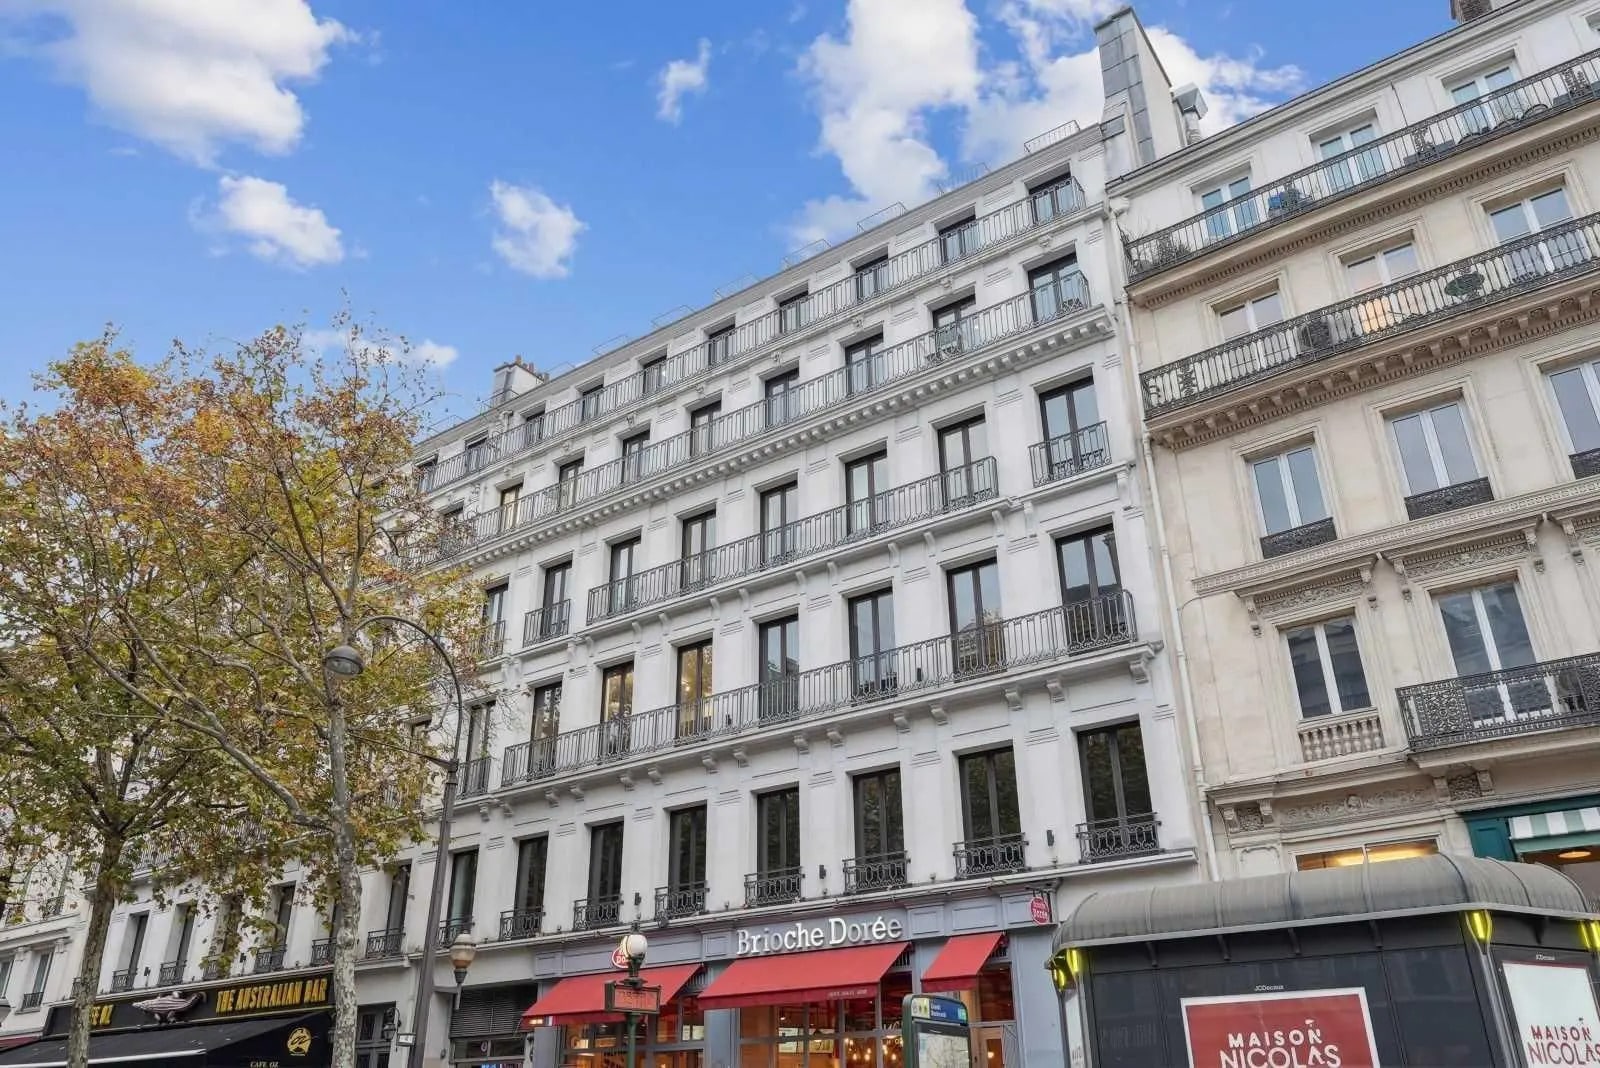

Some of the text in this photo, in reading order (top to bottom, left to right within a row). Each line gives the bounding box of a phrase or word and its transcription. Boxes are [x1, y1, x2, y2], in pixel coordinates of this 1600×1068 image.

[736, 916, 903, 955] Brioche Dorée
[216, 979, 328, 1013] THE AUSTRALIAN BAR
[1228, 1028, 1322, 1049] MAISON
[1530, 1024, 1593, 1042] MAISON
[1220, 1045, 1342, 1068] NICOLAS
